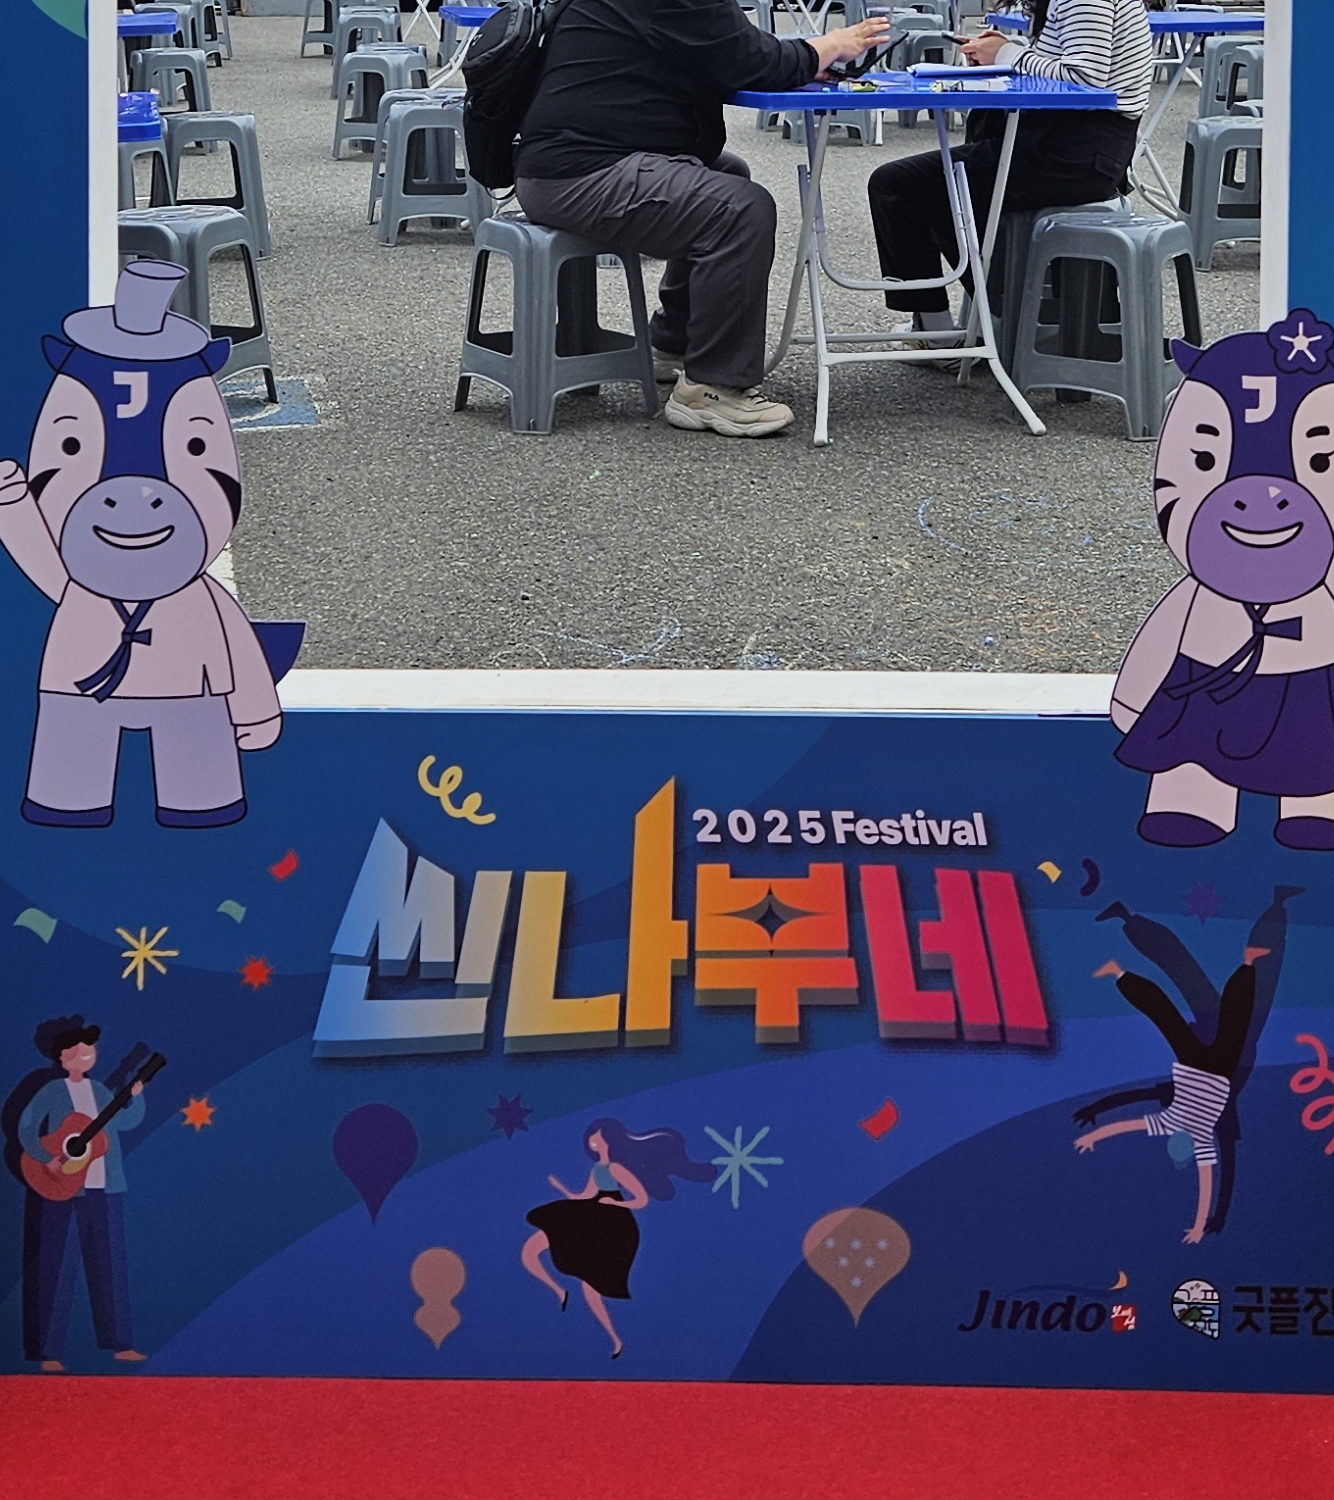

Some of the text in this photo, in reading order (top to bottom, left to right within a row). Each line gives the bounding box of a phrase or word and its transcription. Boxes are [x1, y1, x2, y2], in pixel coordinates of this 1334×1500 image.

[704, 393, 719, 401] FILA
[312, 775, 1051, 1060] 씬나부네
[957, 1289, 1106, 1333] Jindo
